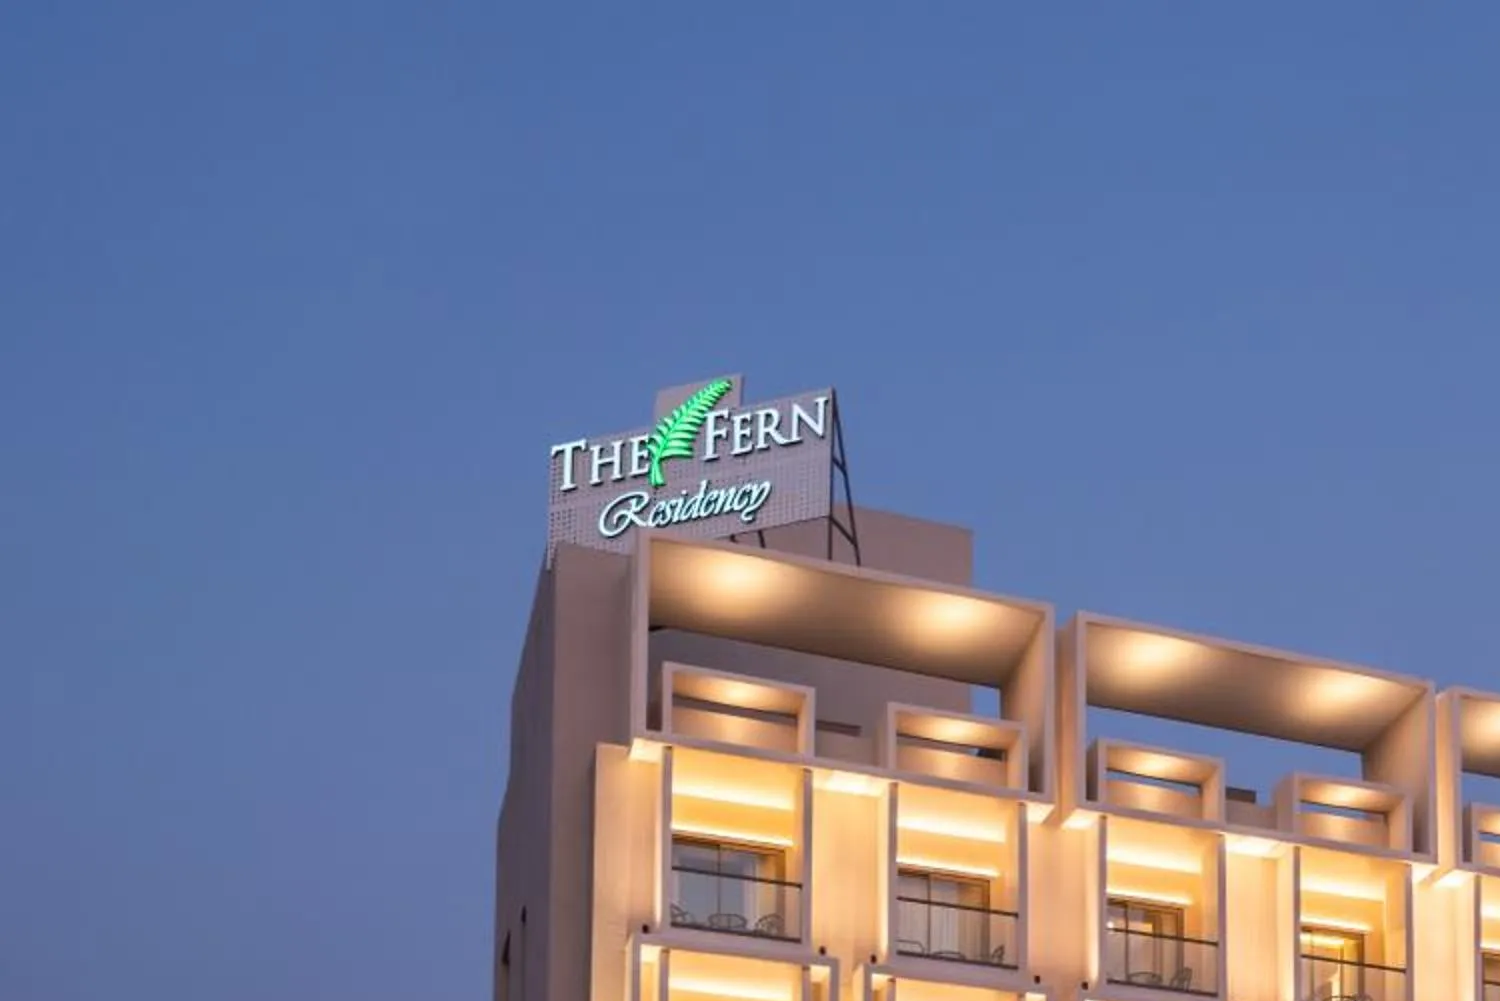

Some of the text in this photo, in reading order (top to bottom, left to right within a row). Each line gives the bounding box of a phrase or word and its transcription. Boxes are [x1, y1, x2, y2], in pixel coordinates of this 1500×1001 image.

[551, 397, 829, 491] THE FERN
[599, 480, 772, 538] Residency
